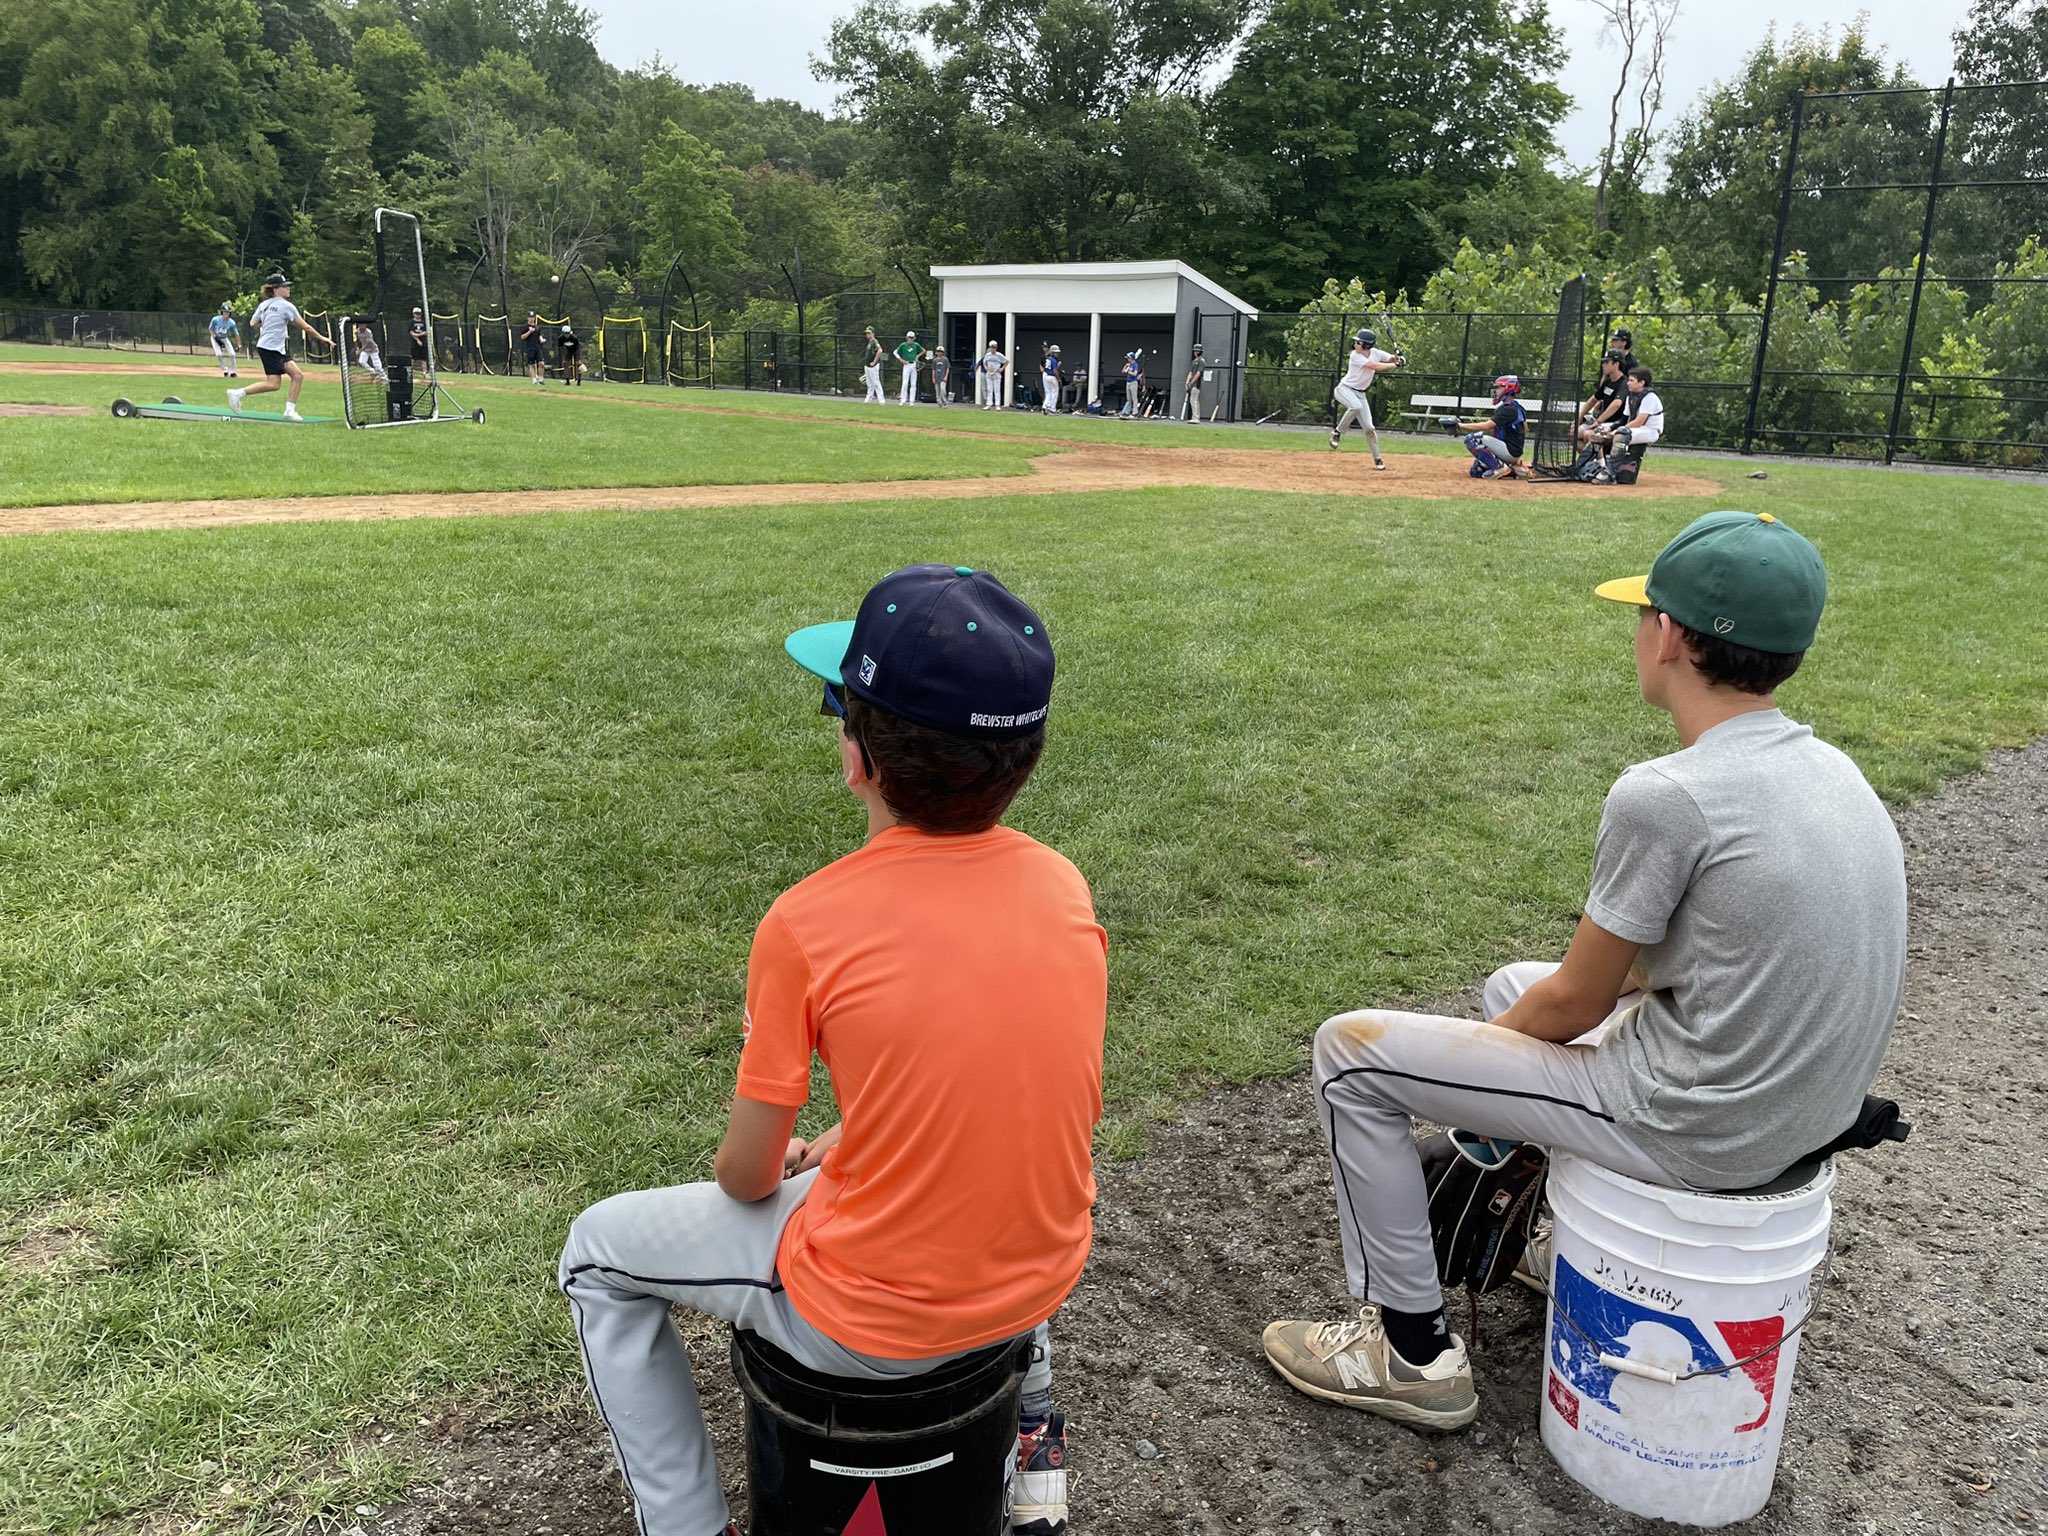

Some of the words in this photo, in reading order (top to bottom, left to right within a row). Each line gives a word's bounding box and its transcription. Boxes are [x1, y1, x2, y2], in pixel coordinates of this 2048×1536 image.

[970, 712, 1015, 728] BREWSTER
[1333, 1349, 1381, 1389] N
[834, 1466, 870, 1476] VARSITY
[871, 1466, 918, 1476] PRE-GAME
